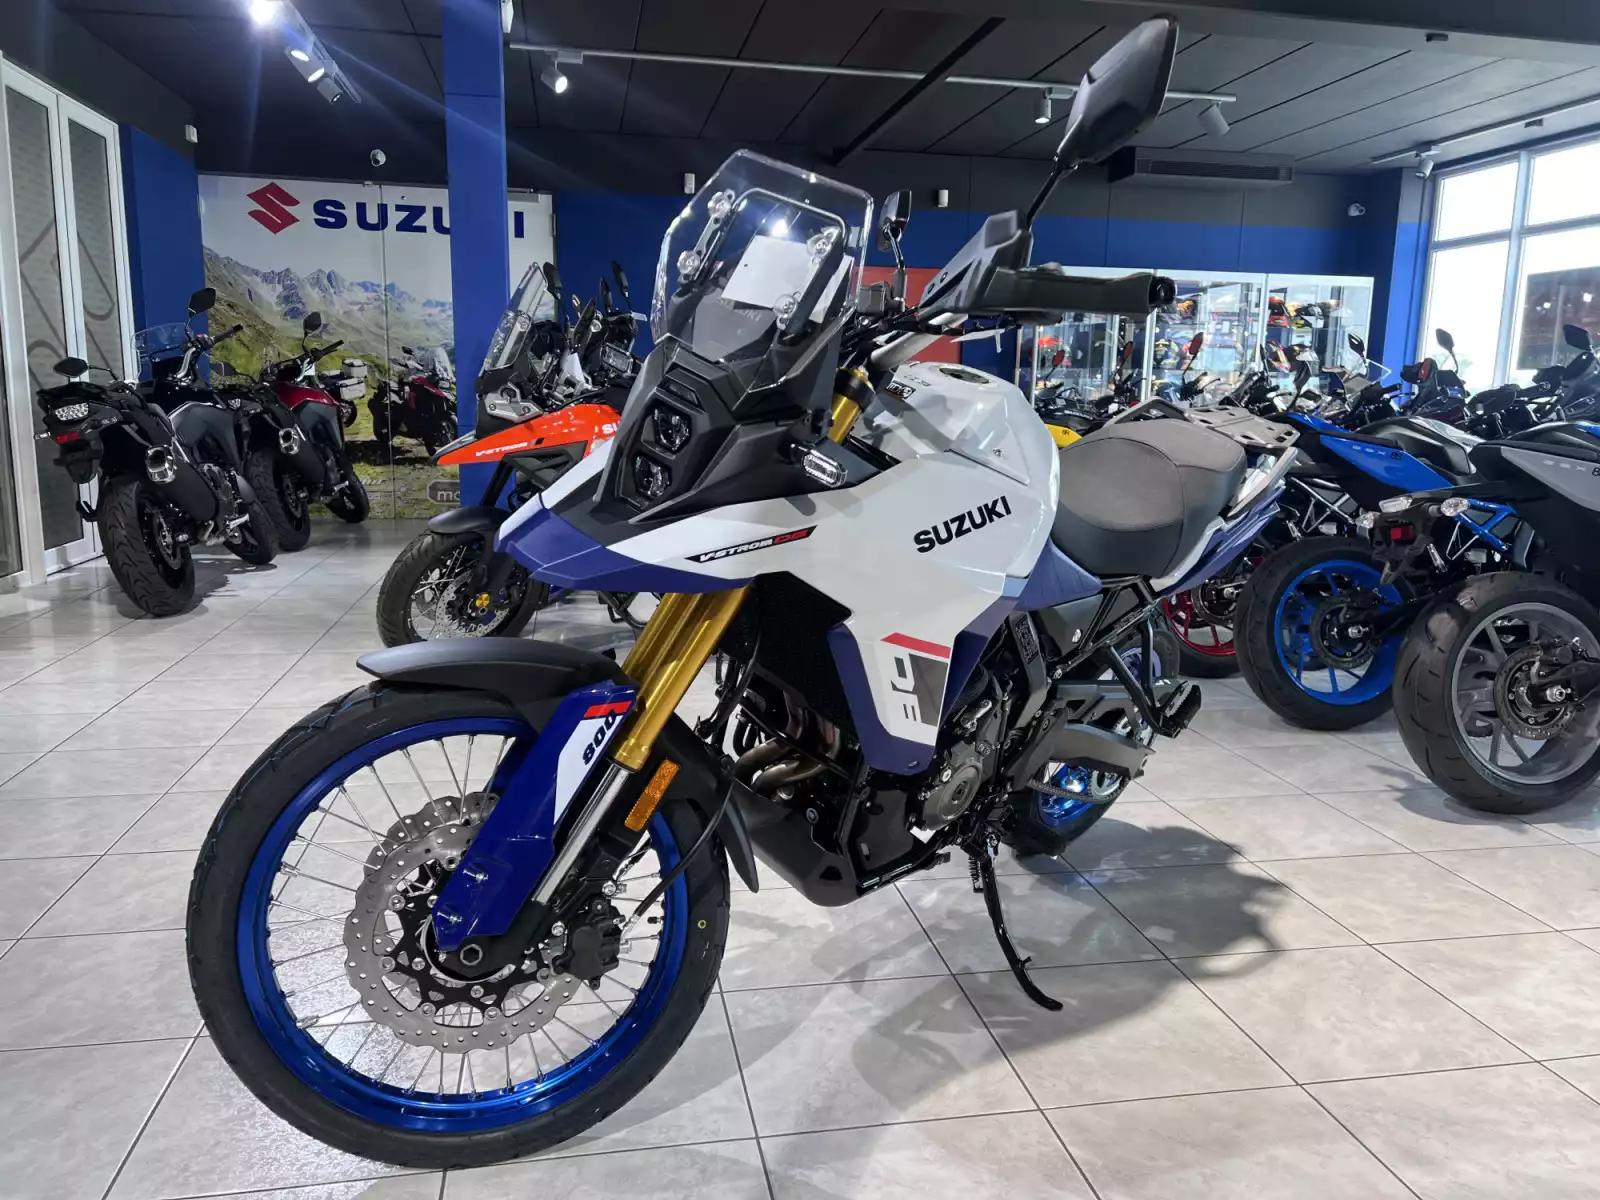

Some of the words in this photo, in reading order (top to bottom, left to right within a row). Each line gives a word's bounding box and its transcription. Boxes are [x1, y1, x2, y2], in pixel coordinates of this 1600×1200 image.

[313, 198, 525, 239] SUZUI
[913, 495, 1012, 554] SUZUKI
[582, 708, 617, 765] 800
